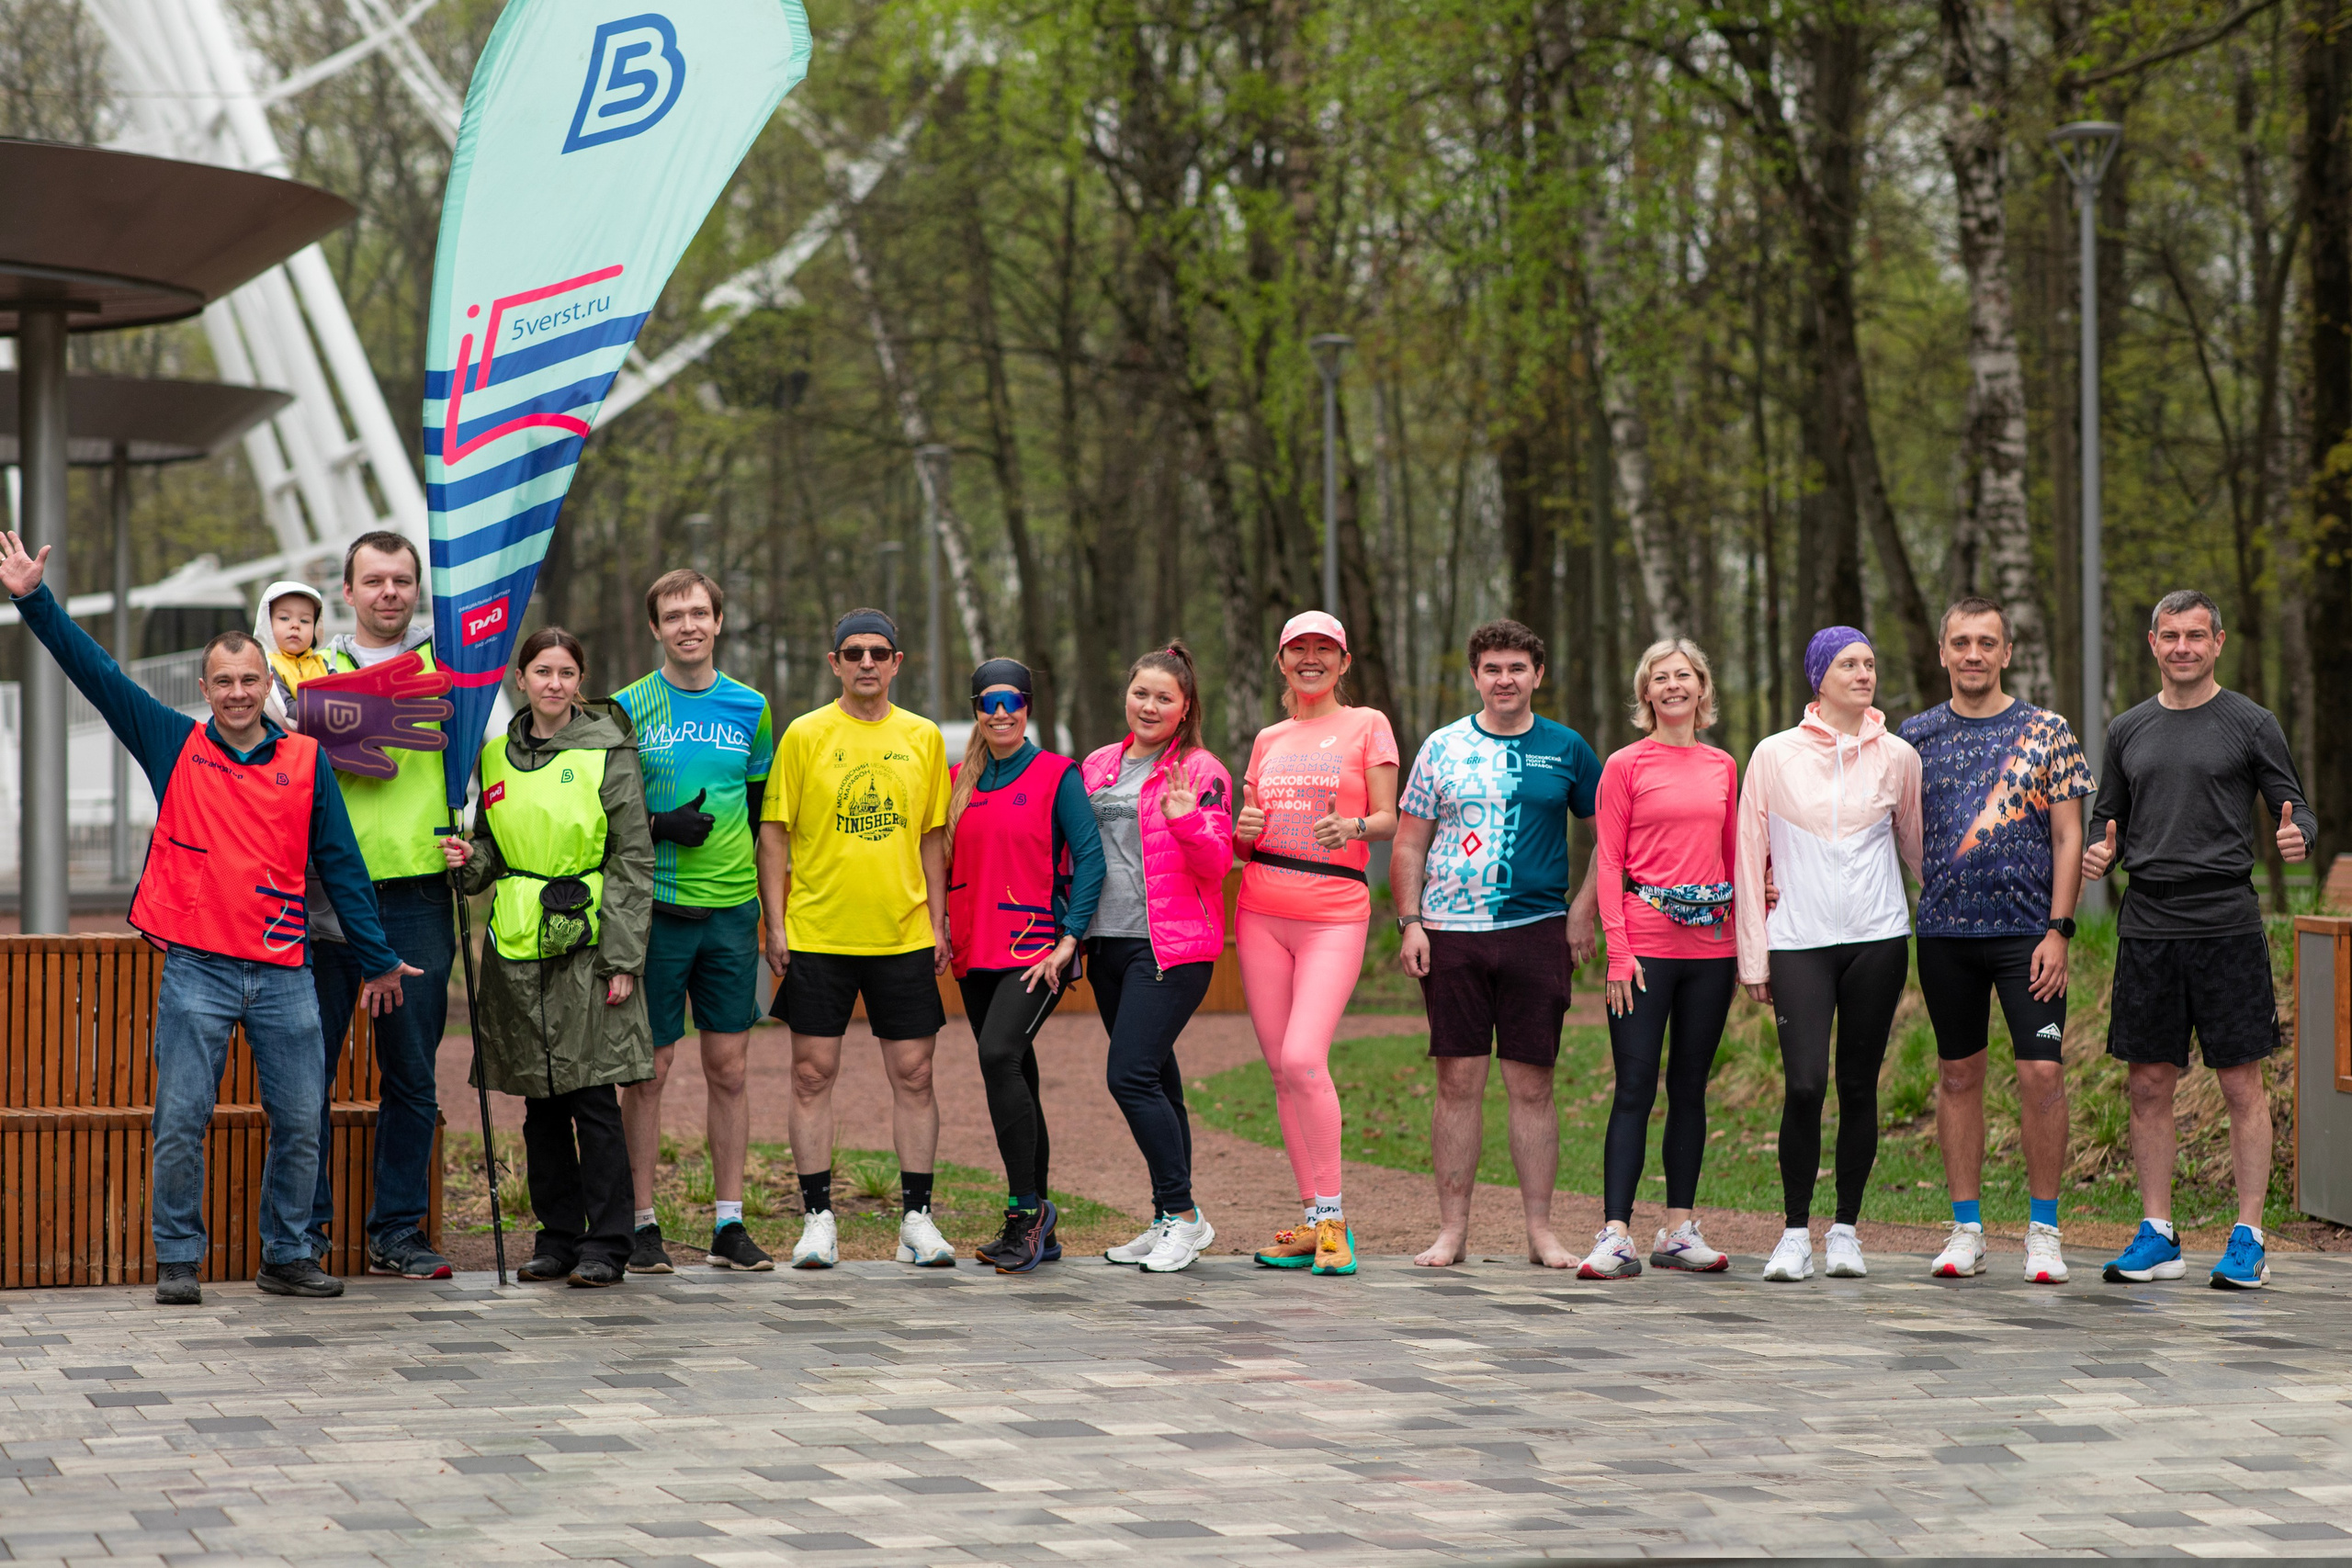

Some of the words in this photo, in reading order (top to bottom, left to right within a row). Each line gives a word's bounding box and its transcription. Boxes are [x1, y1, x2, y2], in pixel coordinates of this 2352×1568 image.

[512, 296, 610, 340] 5verst.ru
[892, 752, 910, 761] asics
[836, 761, 869, 808] МОСКОВСКИЙ
[843, 770, 871, 801] МАРАФОН
[1261, 800, 1312, 811] АРАФОН
[836, 812, 900, 834] FINISHER
